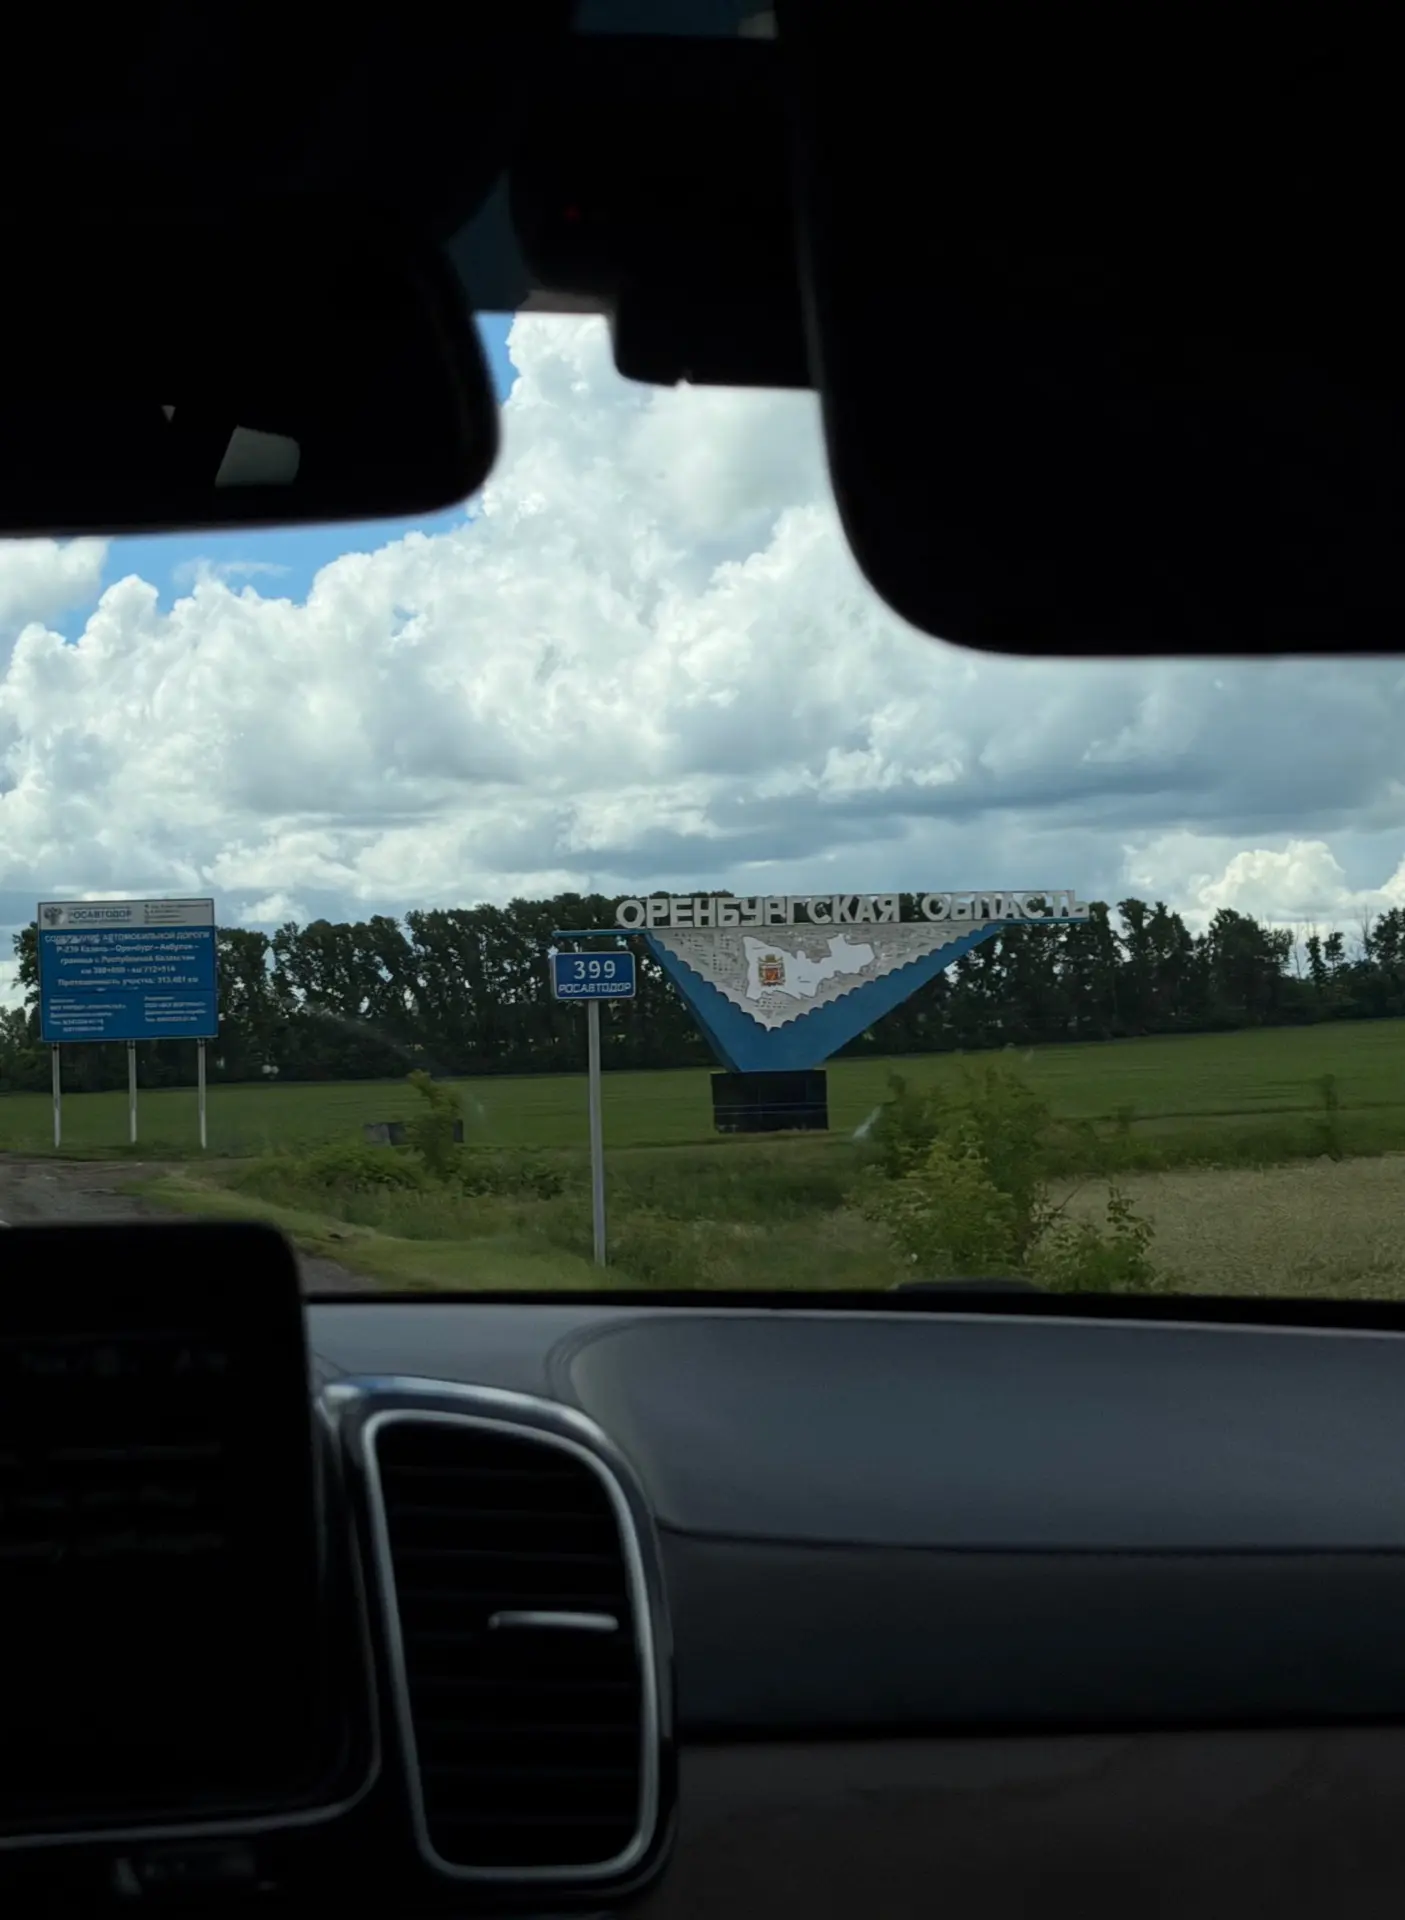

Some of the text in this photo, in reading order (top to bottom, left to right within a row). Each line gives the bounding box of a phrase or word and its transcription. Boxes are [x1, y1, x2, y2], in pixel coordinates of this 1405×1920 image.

[615, 889, 1090, 930] ОРЕНБУРГСКАЯ ОБЛАСТЬ
[573, 960, 617, 980] 399
[558, 982, 632, 994] РОСАВТОДОР
